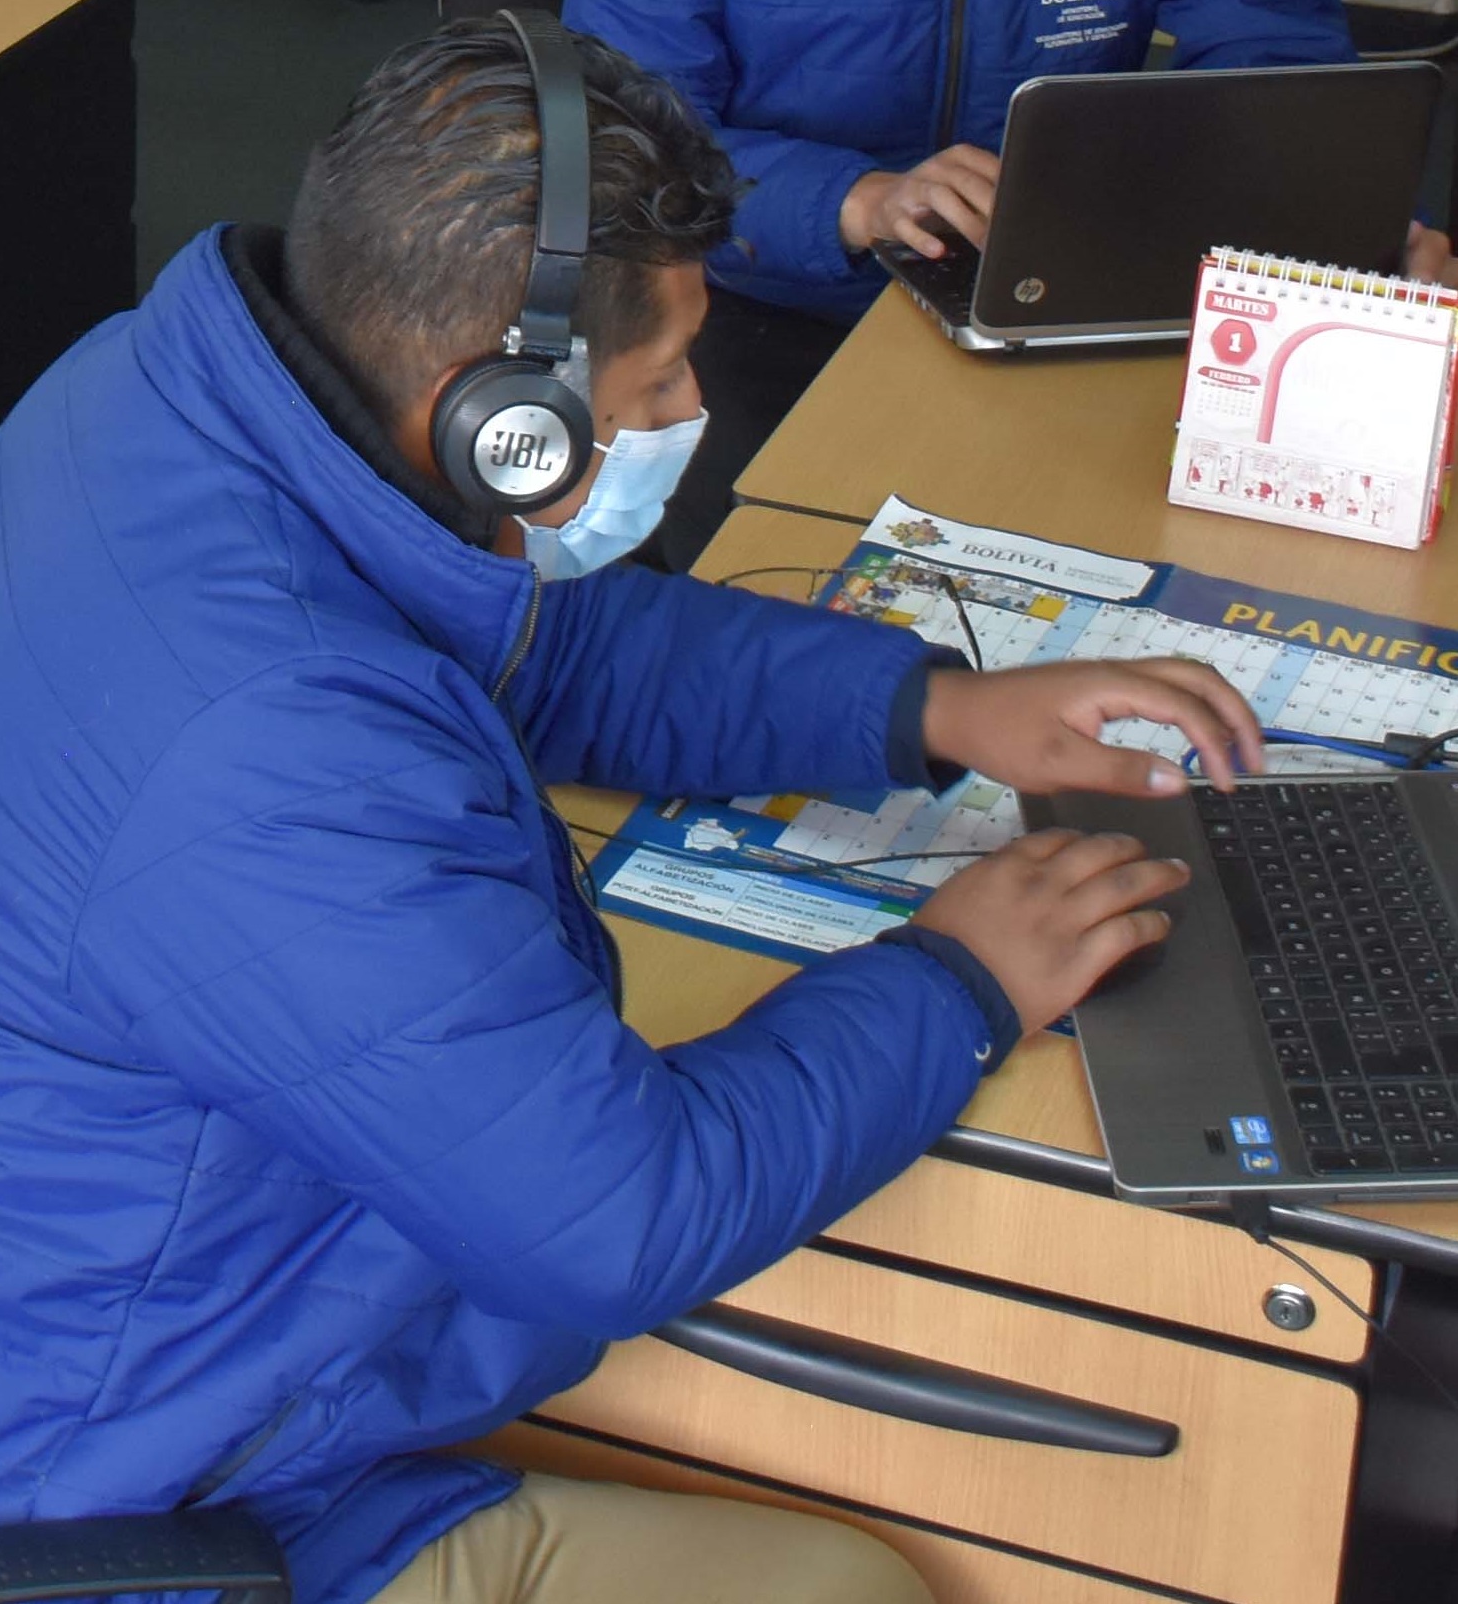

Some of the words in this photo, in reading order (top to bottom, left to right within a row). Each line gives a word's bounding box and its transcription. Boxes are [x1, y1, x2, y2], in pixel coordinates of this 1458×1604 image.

[1212, 293, 1270, 317] MARTES
[1229, 332, 1243, 354] 1
[490, 430, 553, 472] JBL
[960, 543, 1060, 574] BOLIVIA
